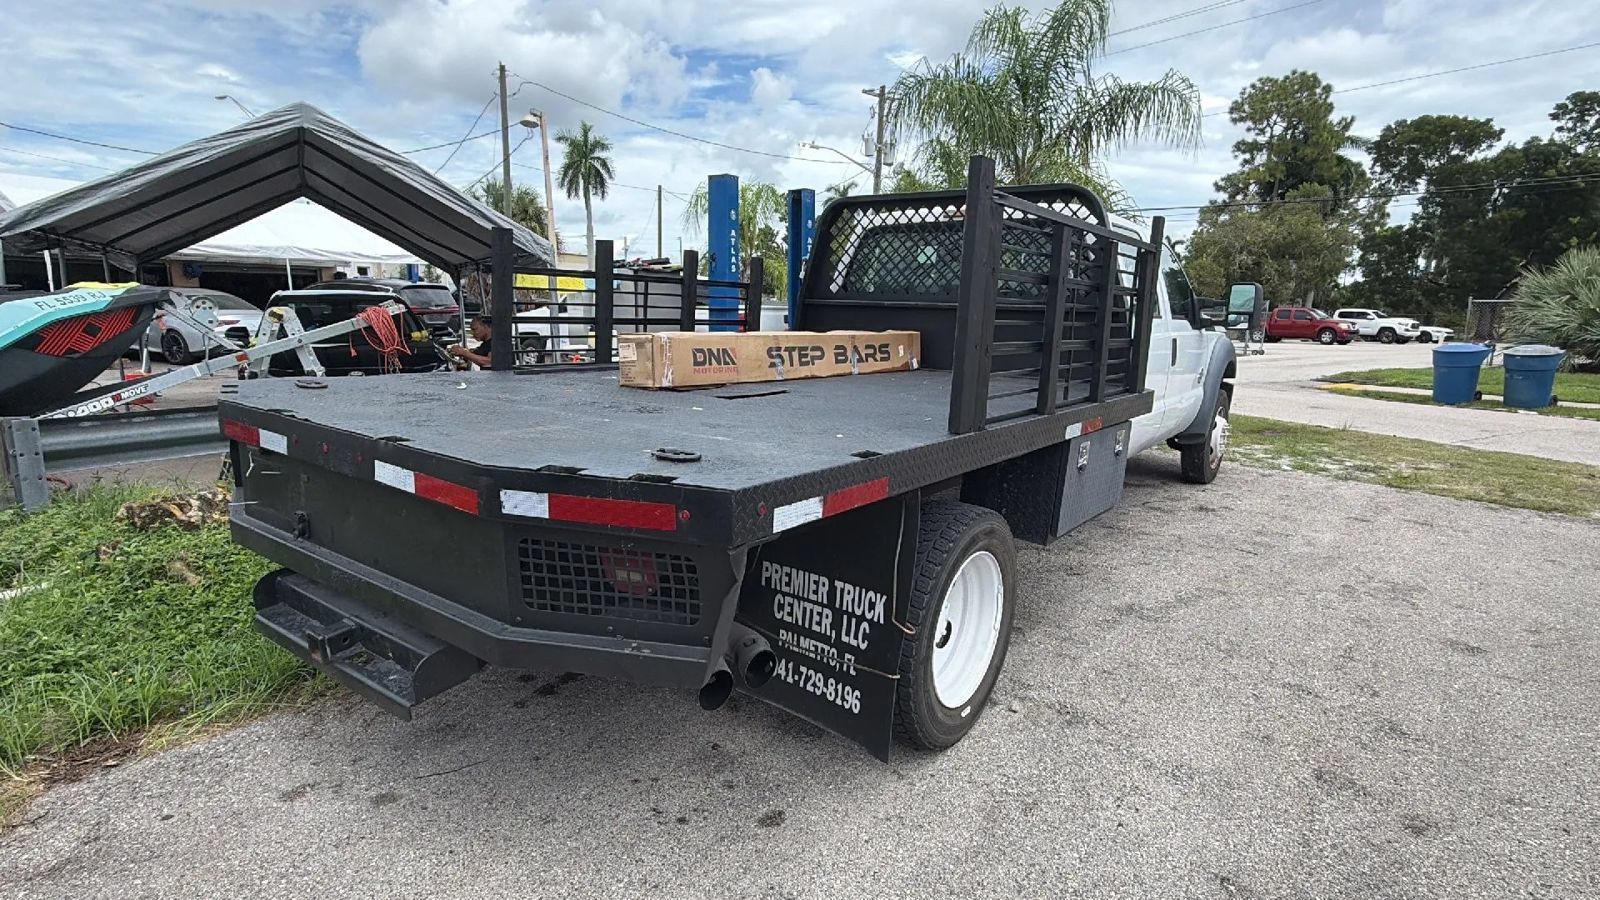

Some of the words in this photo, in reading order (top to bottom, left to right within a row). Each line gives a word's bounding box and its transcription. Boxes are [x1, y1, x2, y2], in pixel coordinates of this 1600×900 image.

[34, 300, 56, 311] FL
[691, 347, 737, 367] DNA
[766, 345, 826, 369] STEP
[833, 343, 891, 365] BARS
[121, 385, 147, 400] MOVE
[761, 560, 830, 605] PREMIER
[834, 579, 887, 625] TRUCK
[773, 593, 836, 644] CENTER,
[841, 614, 870, 651] LLC
[843, 652, 857, 676] FL
[773, 658, 861, 714] 41-729-8196
